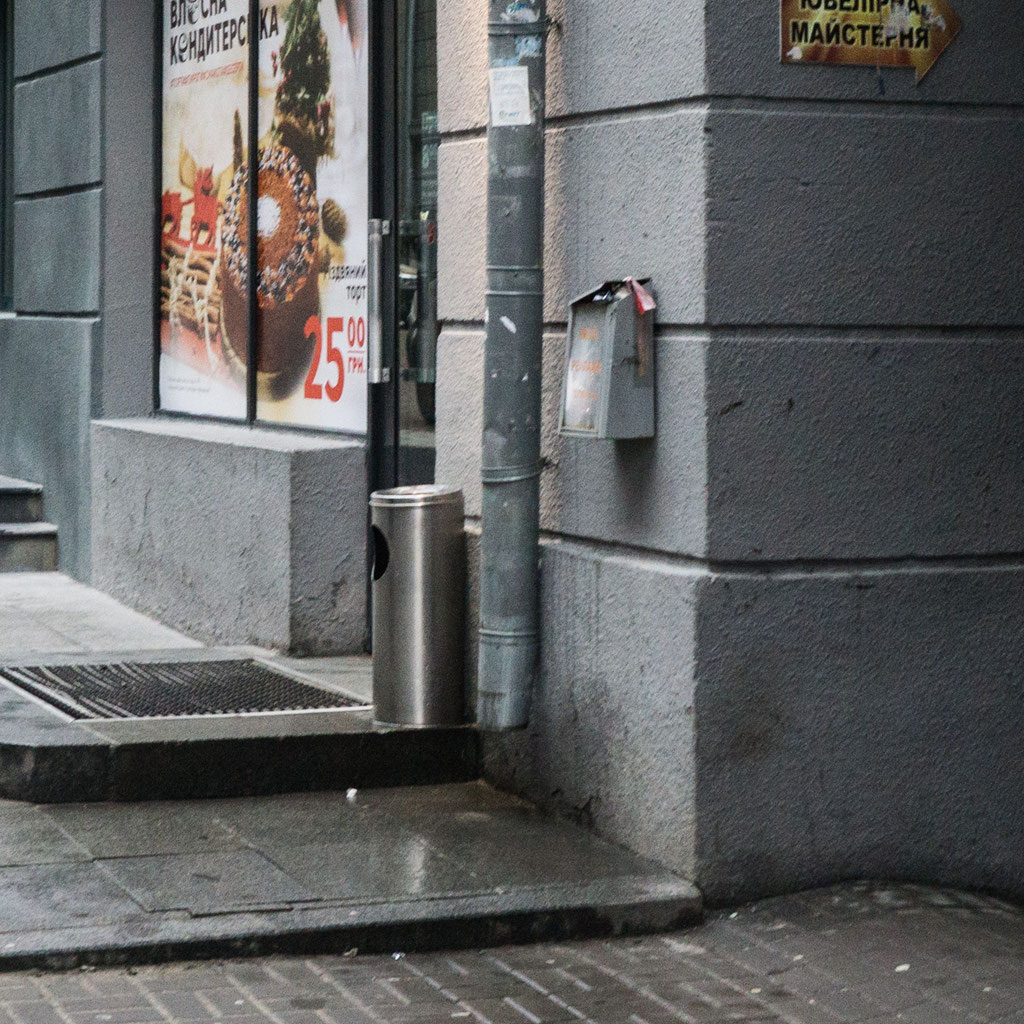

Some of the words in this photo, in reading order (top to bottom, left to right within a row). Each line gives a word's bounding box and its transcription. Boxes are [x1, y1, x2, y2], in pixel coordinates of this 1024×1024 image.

[170, 5, 279, 65] КОНДИТЕРСКА
[304, 316, 344, 402] 25
[347, 316, 365, 348] 00
